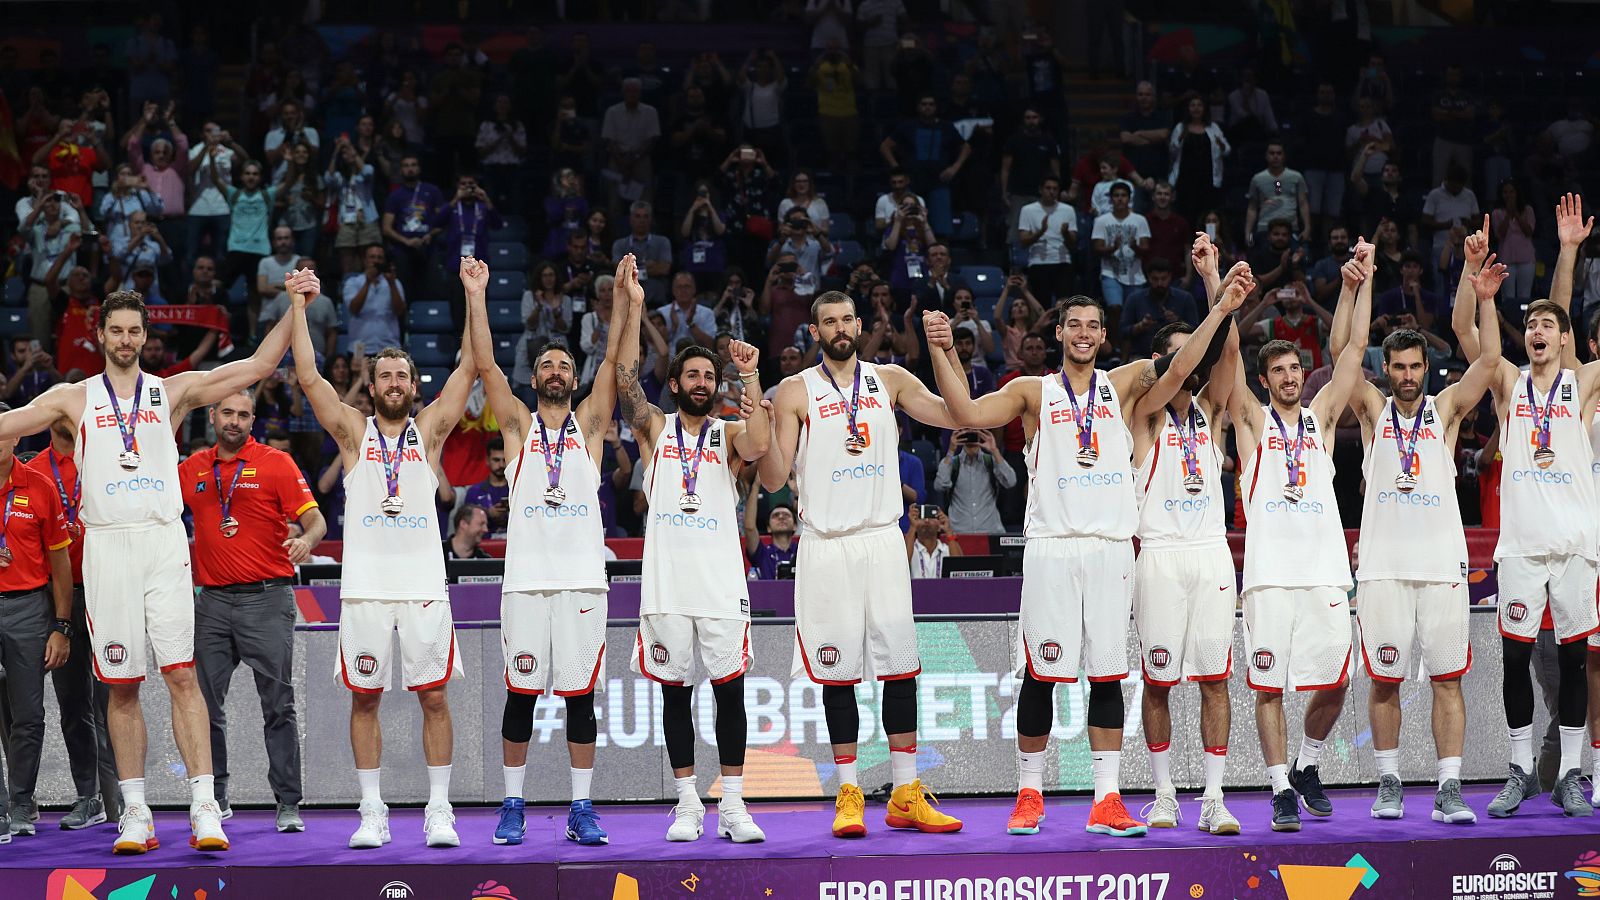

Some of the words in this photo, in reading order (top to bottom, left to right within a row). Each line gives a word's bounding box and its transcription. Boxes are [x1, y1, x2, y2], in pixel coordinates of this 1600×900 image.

[832, 462, 884, 482] endea
[1512, 469, 1572, 484] endesa
[1057, 471, 1122, 490] endesa
[1164, 495, 1210, 512] ende
[1378, 491, 1440, 506] endesa
[524, 504, 588, 518] endesa
[362, 514, 428, 528] endesa
[1511, 607, 1525, 618] FIAT
[108, 648, 123, 660] FIAT
[652, 648, 666, 661] FIAT
[821, 650, 836, 662] FIAT
[1044, 646, 1059, 658] FIAT
[1381, 650, 1395, 662] FIAT
[518, 658, 533, 670] FIAT
[1152, 653, 1167, 664] FIAT
[1256, 655, 1272, 667] FIAT
[359, 658, 375, 672] FIAT
[1495, 861, 1515, 871] FIBA
[819, 879, 887, 900] FIBA
[894, 875, 1094, 900] EUROBASKET
[1097, 873, 1170, 900] 2017
[1452, 871, 1558, 893] EUROBASKET
[386, 888, 407, 899] FIBA
[1533, 891, 1555, 899] TURKEY
